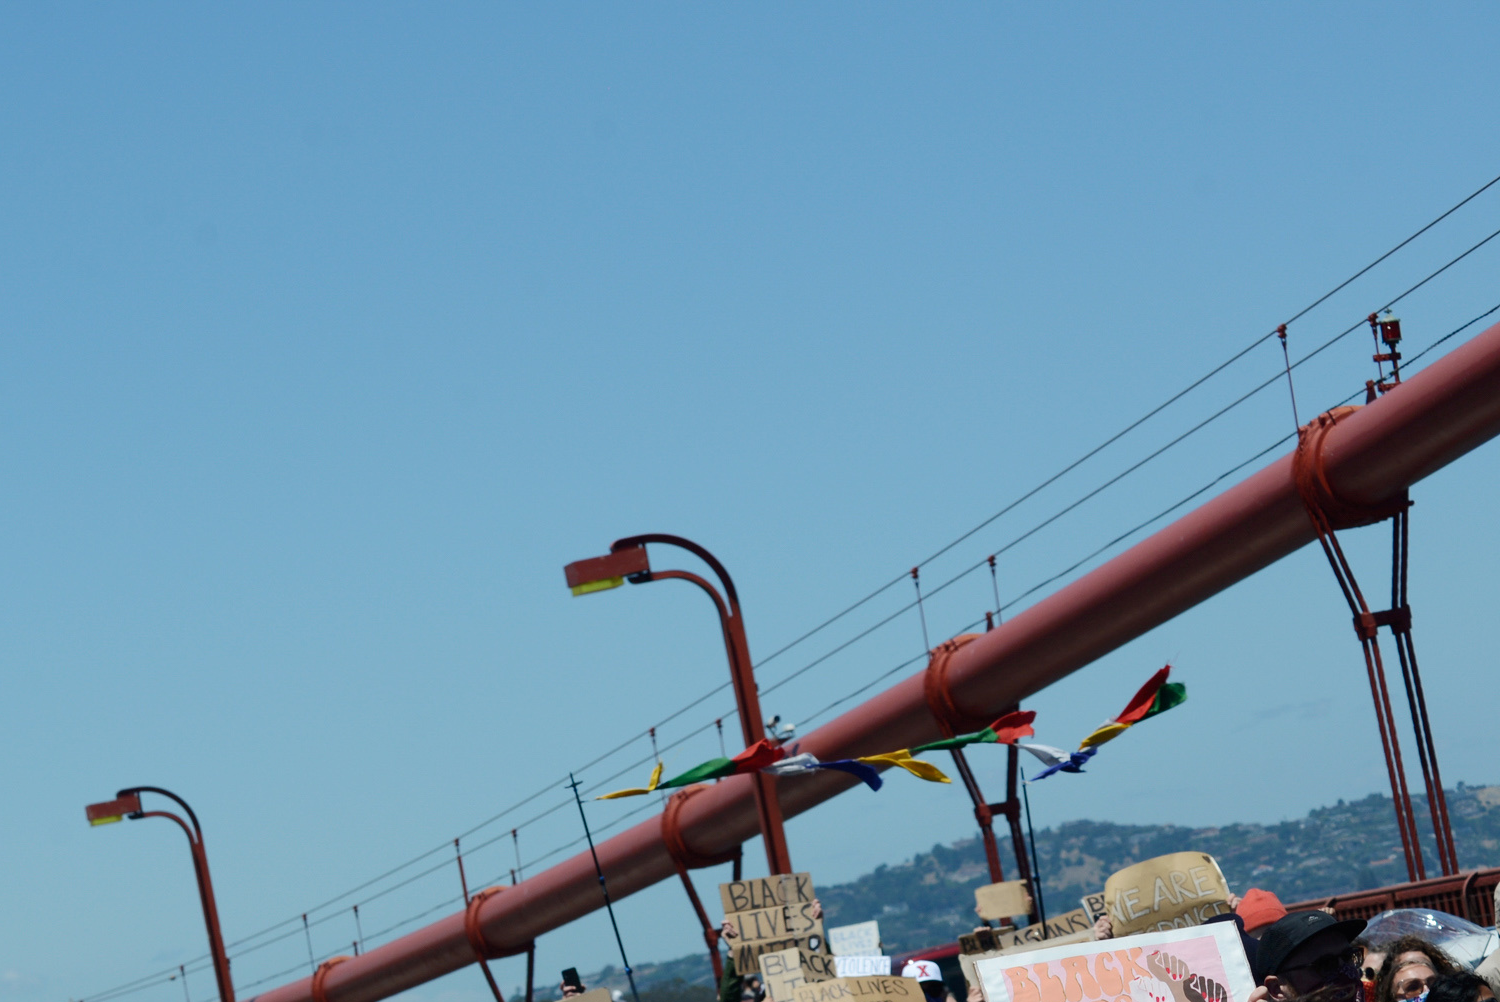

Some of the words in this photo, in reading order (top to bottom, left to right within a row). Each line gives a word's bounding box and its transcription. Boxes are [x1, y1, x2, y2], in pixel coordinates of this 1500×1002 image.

[728, 876, 809, 912] BLACK
[1153, 866, 1216, 912] ARE
[737, 903, 815, 941] LIVES
[856, 978, 910, 997] LIVES
